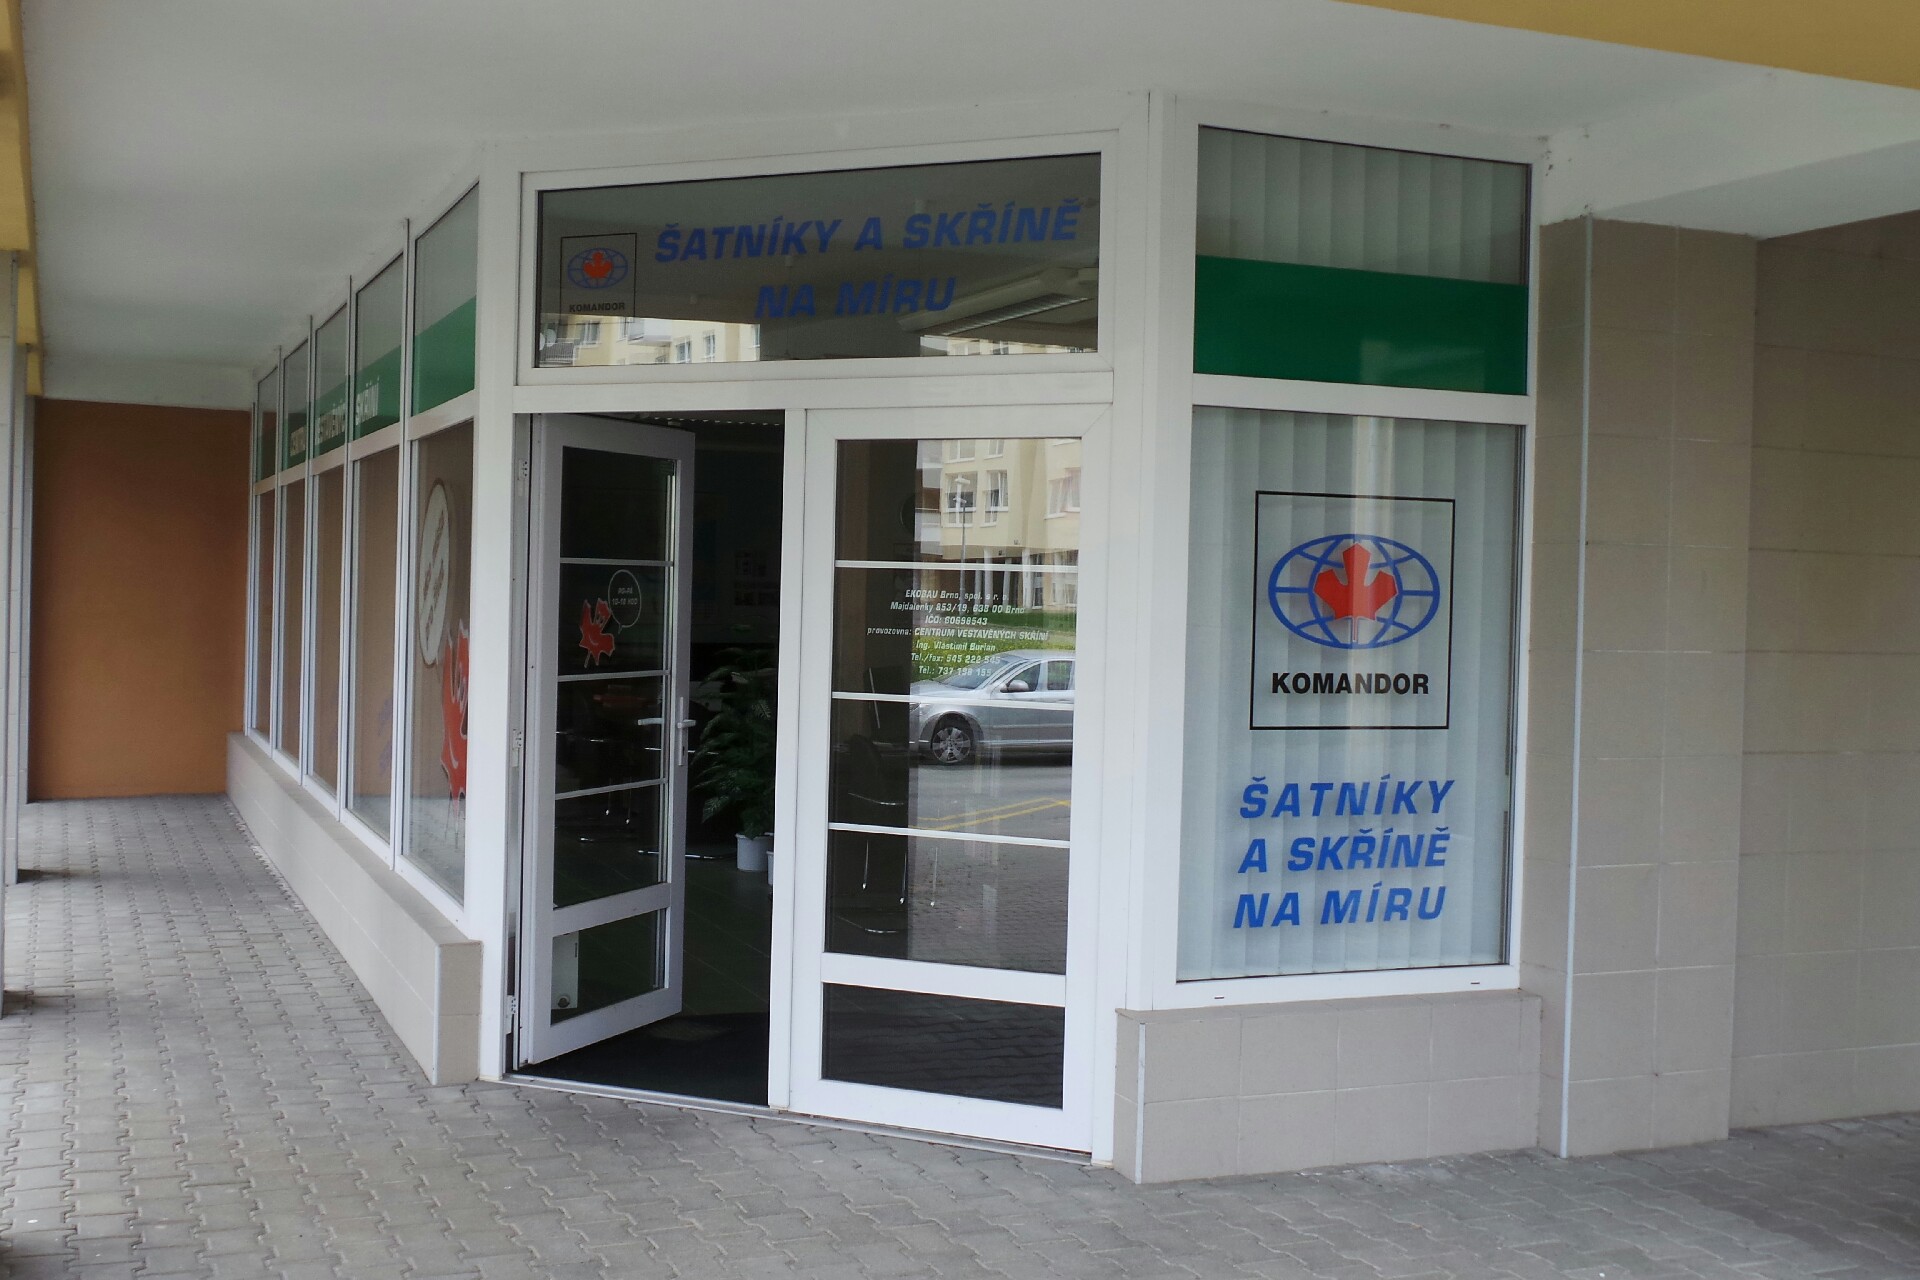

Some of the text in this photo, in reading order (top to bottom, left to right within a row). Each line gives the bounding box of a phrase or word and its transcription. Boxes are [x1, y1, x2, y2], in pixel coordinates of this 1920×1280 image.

[655, 198, 1080, 262] ŠATNÍKY A SKŘÍNĚ
[754, 273, 956, 318] NA MÍRU
[569, 301, 625, 314] KOMANDOR
[905, 589, 938, 599] EKOBAU
[890, 601, 933, 613] Majdalenky
[867, 628, 912, 636] provozovna:
[914, 627, 954, 637] CENTRUM
[957, 627, 1016, 639] VESTAVĚNÝCH
[946, 654, 963, 663] 545
[1272, 672, 1429, 694] KOMANDOR
[1240, 774, 1455, 819] ŠATNÍKY
[1237, 826, 1450, 873] A SKŘÍNĚ
[1233, 881, 1446, 928] NA MÍRU
